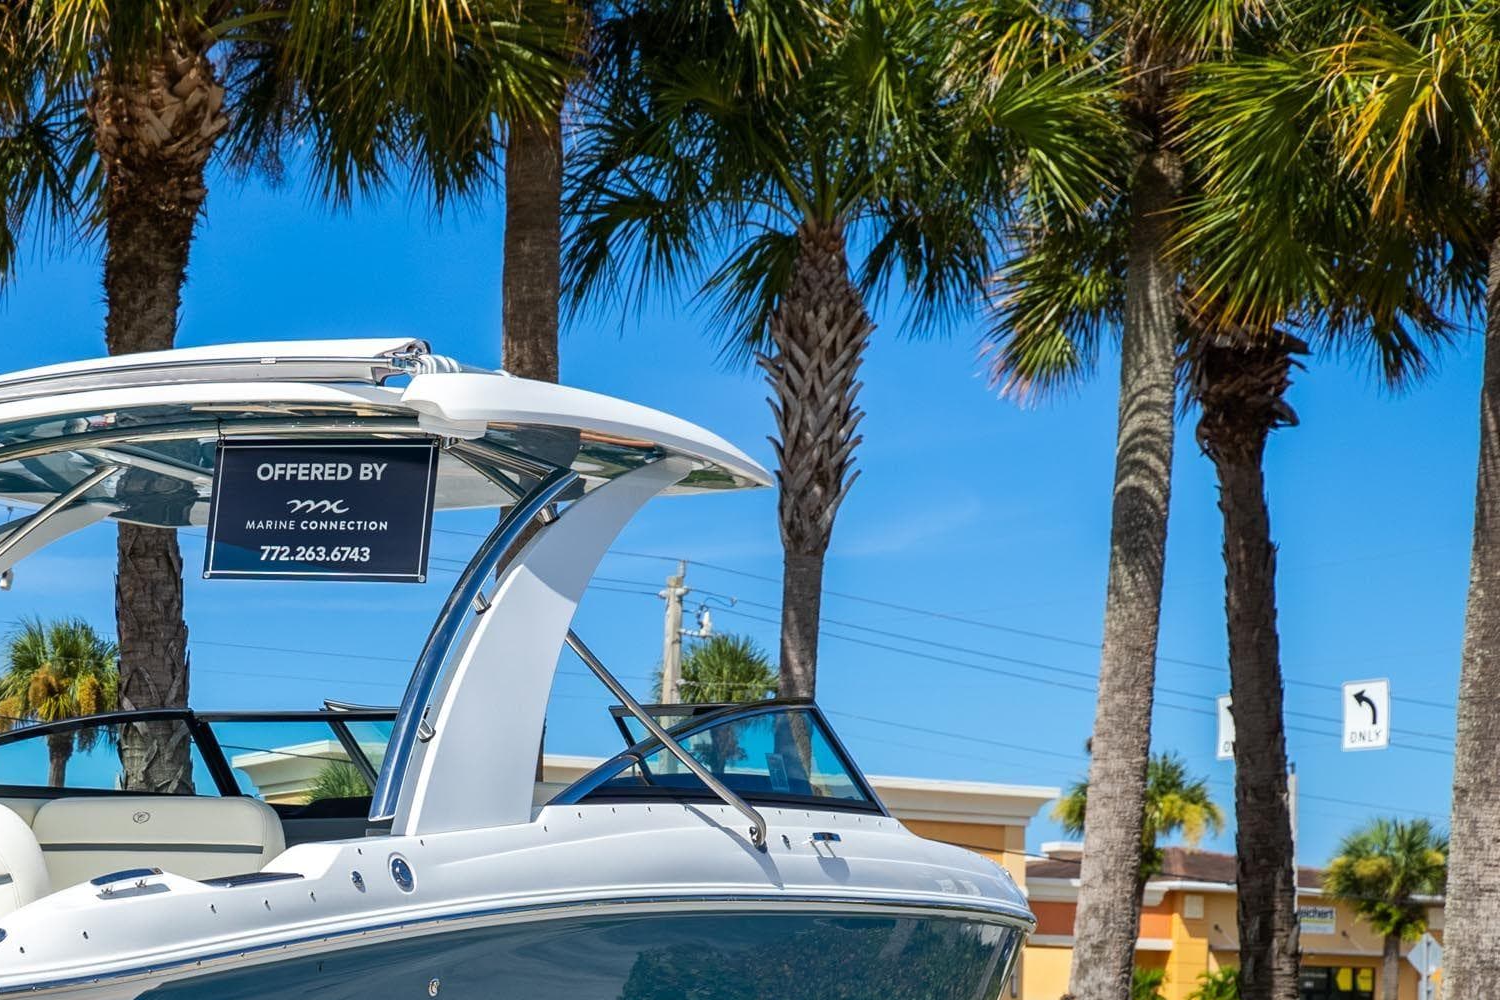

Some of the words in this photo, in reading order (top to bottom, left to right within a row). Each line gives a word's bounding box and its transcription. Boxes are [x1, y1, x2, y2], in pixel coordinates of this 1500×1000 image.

[256, 463, 352, 481] OFFERED
[359, 463, 388, 481] BY
[245, 520, 296, 530] MARINE
[300, 520, 388, 531] CONNECTION
[260, 546, 371, 562] 772.263.6743
[1350, 730, 1382, 745] ONLY
